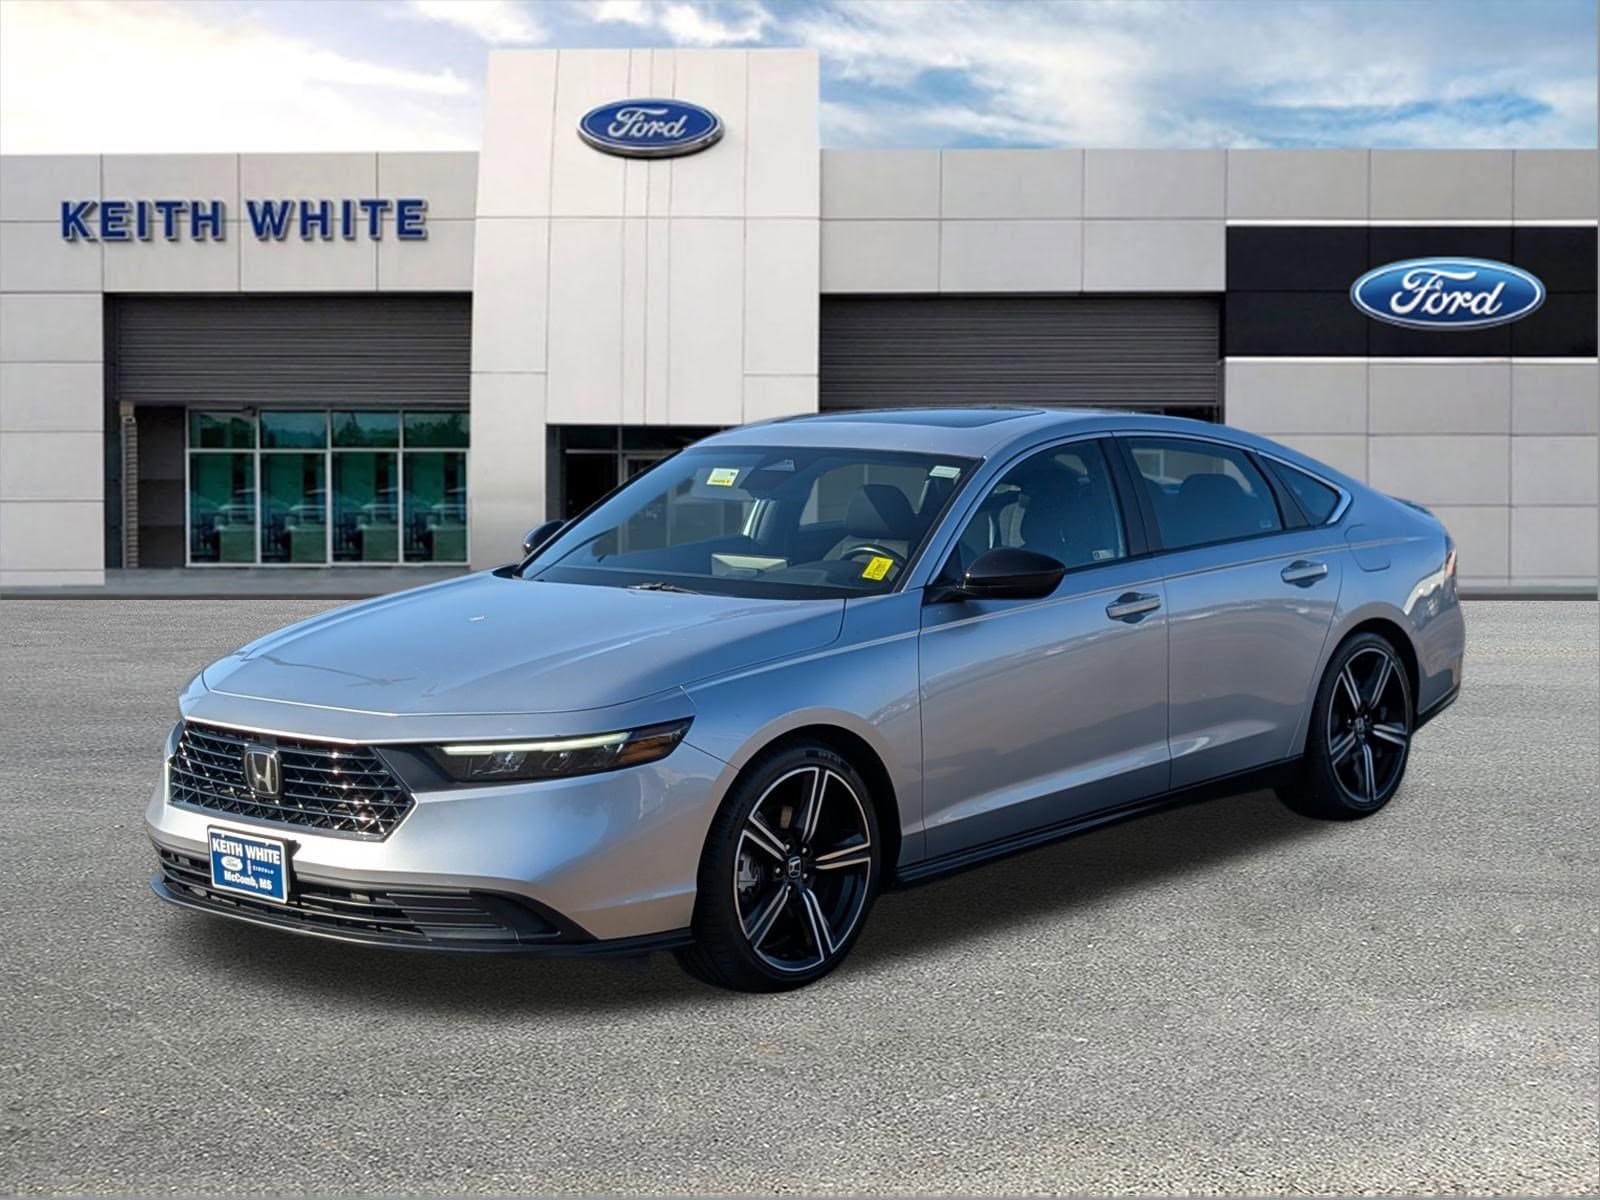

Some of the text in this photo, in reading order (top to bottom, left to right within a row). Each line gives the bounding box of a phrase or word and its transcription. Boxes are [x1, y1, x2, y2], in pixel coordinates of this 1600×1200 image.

[607, 106, 688, 137] Ford
[61, 199, 427, 240] KEITH WHITE
[1390, 268, 1506, 315] Ford
[213, 838, 243, 857] KEITH
[245, 845, 280, 864] WHITE
